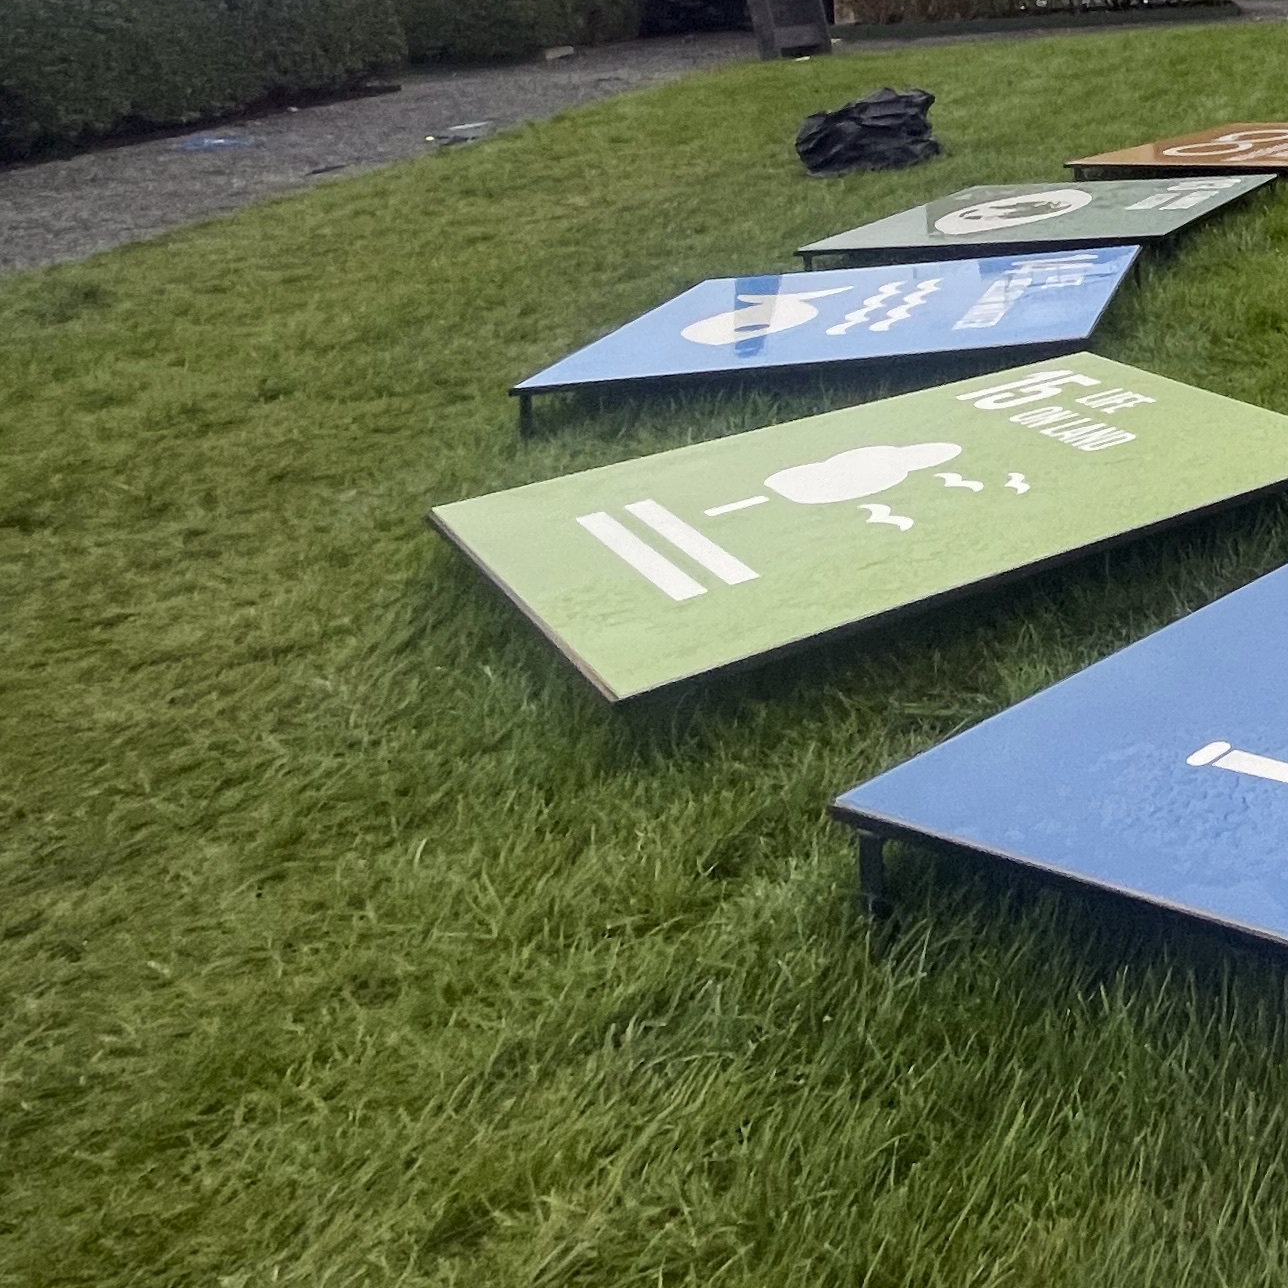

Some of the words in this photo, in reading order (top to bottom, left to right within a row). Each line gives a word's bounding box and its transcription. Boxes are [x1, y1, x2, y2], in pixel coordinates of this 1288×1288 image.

[955, 369, 1102, 411] 15
[1074, 387, 1157, 414] LIFE
[1008, 405, 1080, 429] ON
[1038, 417, 1137, 452] LAND
